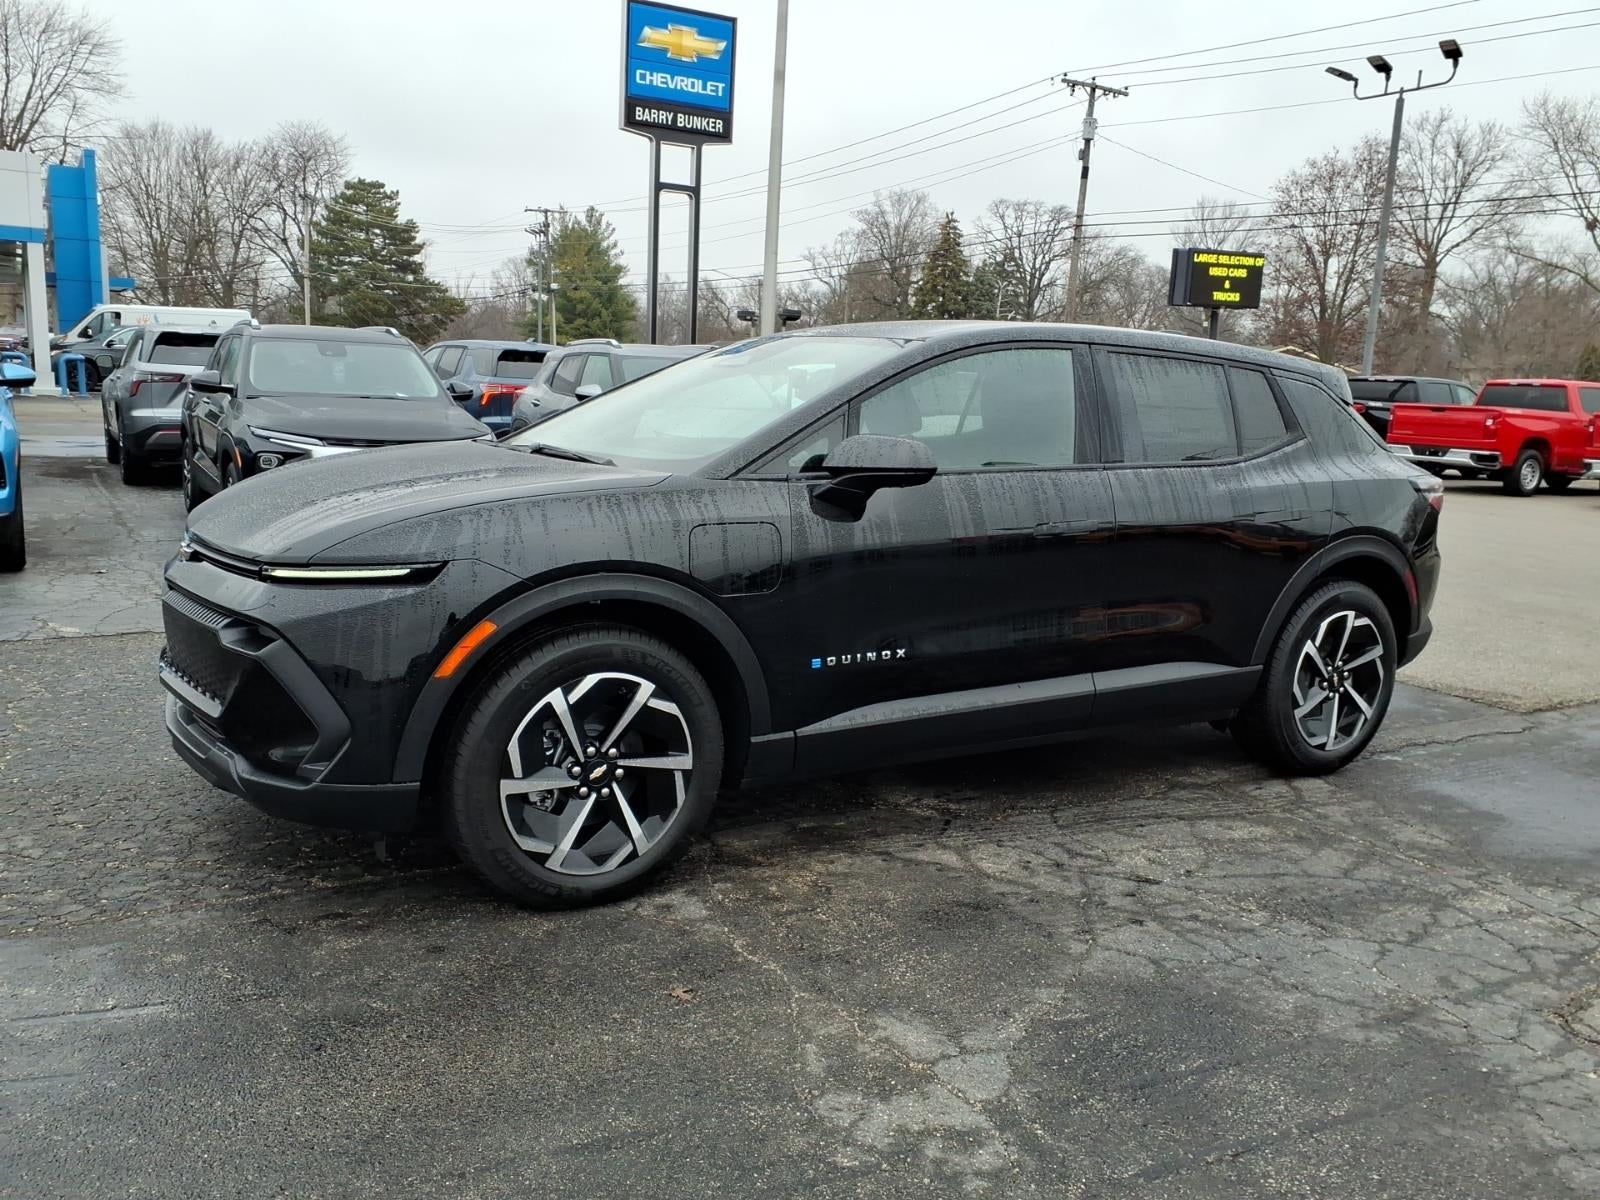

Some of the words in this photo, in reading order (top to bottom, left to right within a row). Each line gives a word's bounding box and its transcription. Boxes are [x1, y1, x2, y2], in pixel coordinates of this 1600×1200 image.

[635, 69, 725, 96] CHEVROLET
[635, 106, 674, 126] BARRY
[677, 113, 723, 133] BUNKER
[1194, 253, 1218, 263] LARGE
[1218, 255, 1254, 266] SELECTION
[1255, 258, 1265, 266] OF
[1209, 267, 1227, 276] USED
[1228, 268, 1247, 277] CARS
[1213, 291, 1240, 301] TRUCKS
[811, 648, 906, 669] EQUINOX
